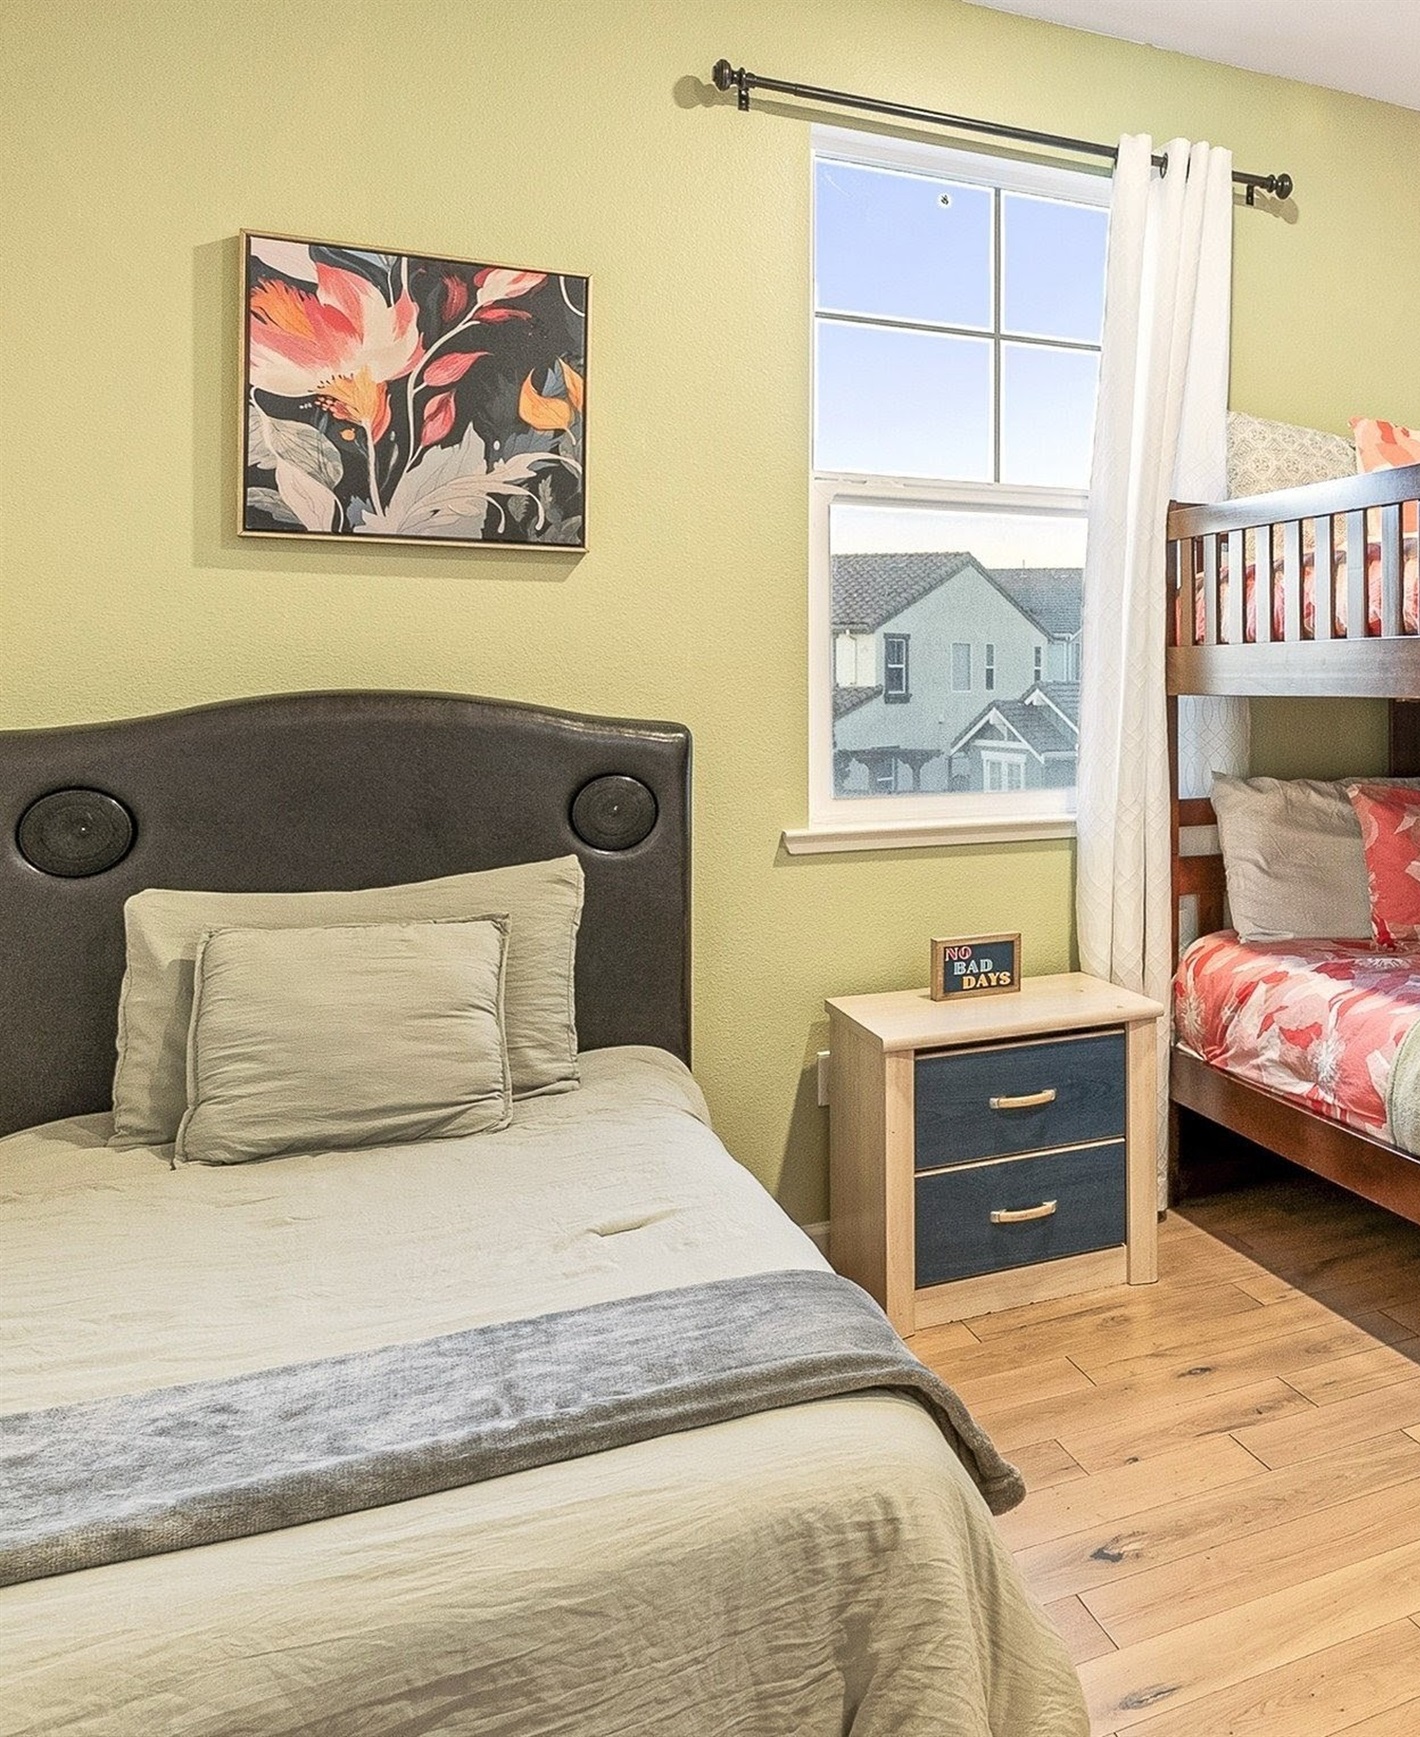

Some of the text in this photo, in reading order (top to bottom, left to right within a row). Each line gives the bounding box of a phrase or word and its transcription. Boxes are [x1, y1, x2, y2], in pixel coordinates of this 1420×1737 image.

[945, 946, 972, 961] NO
[953, 959, 993, 975] BAD
[962, 971, 1011, 989] DAYS
